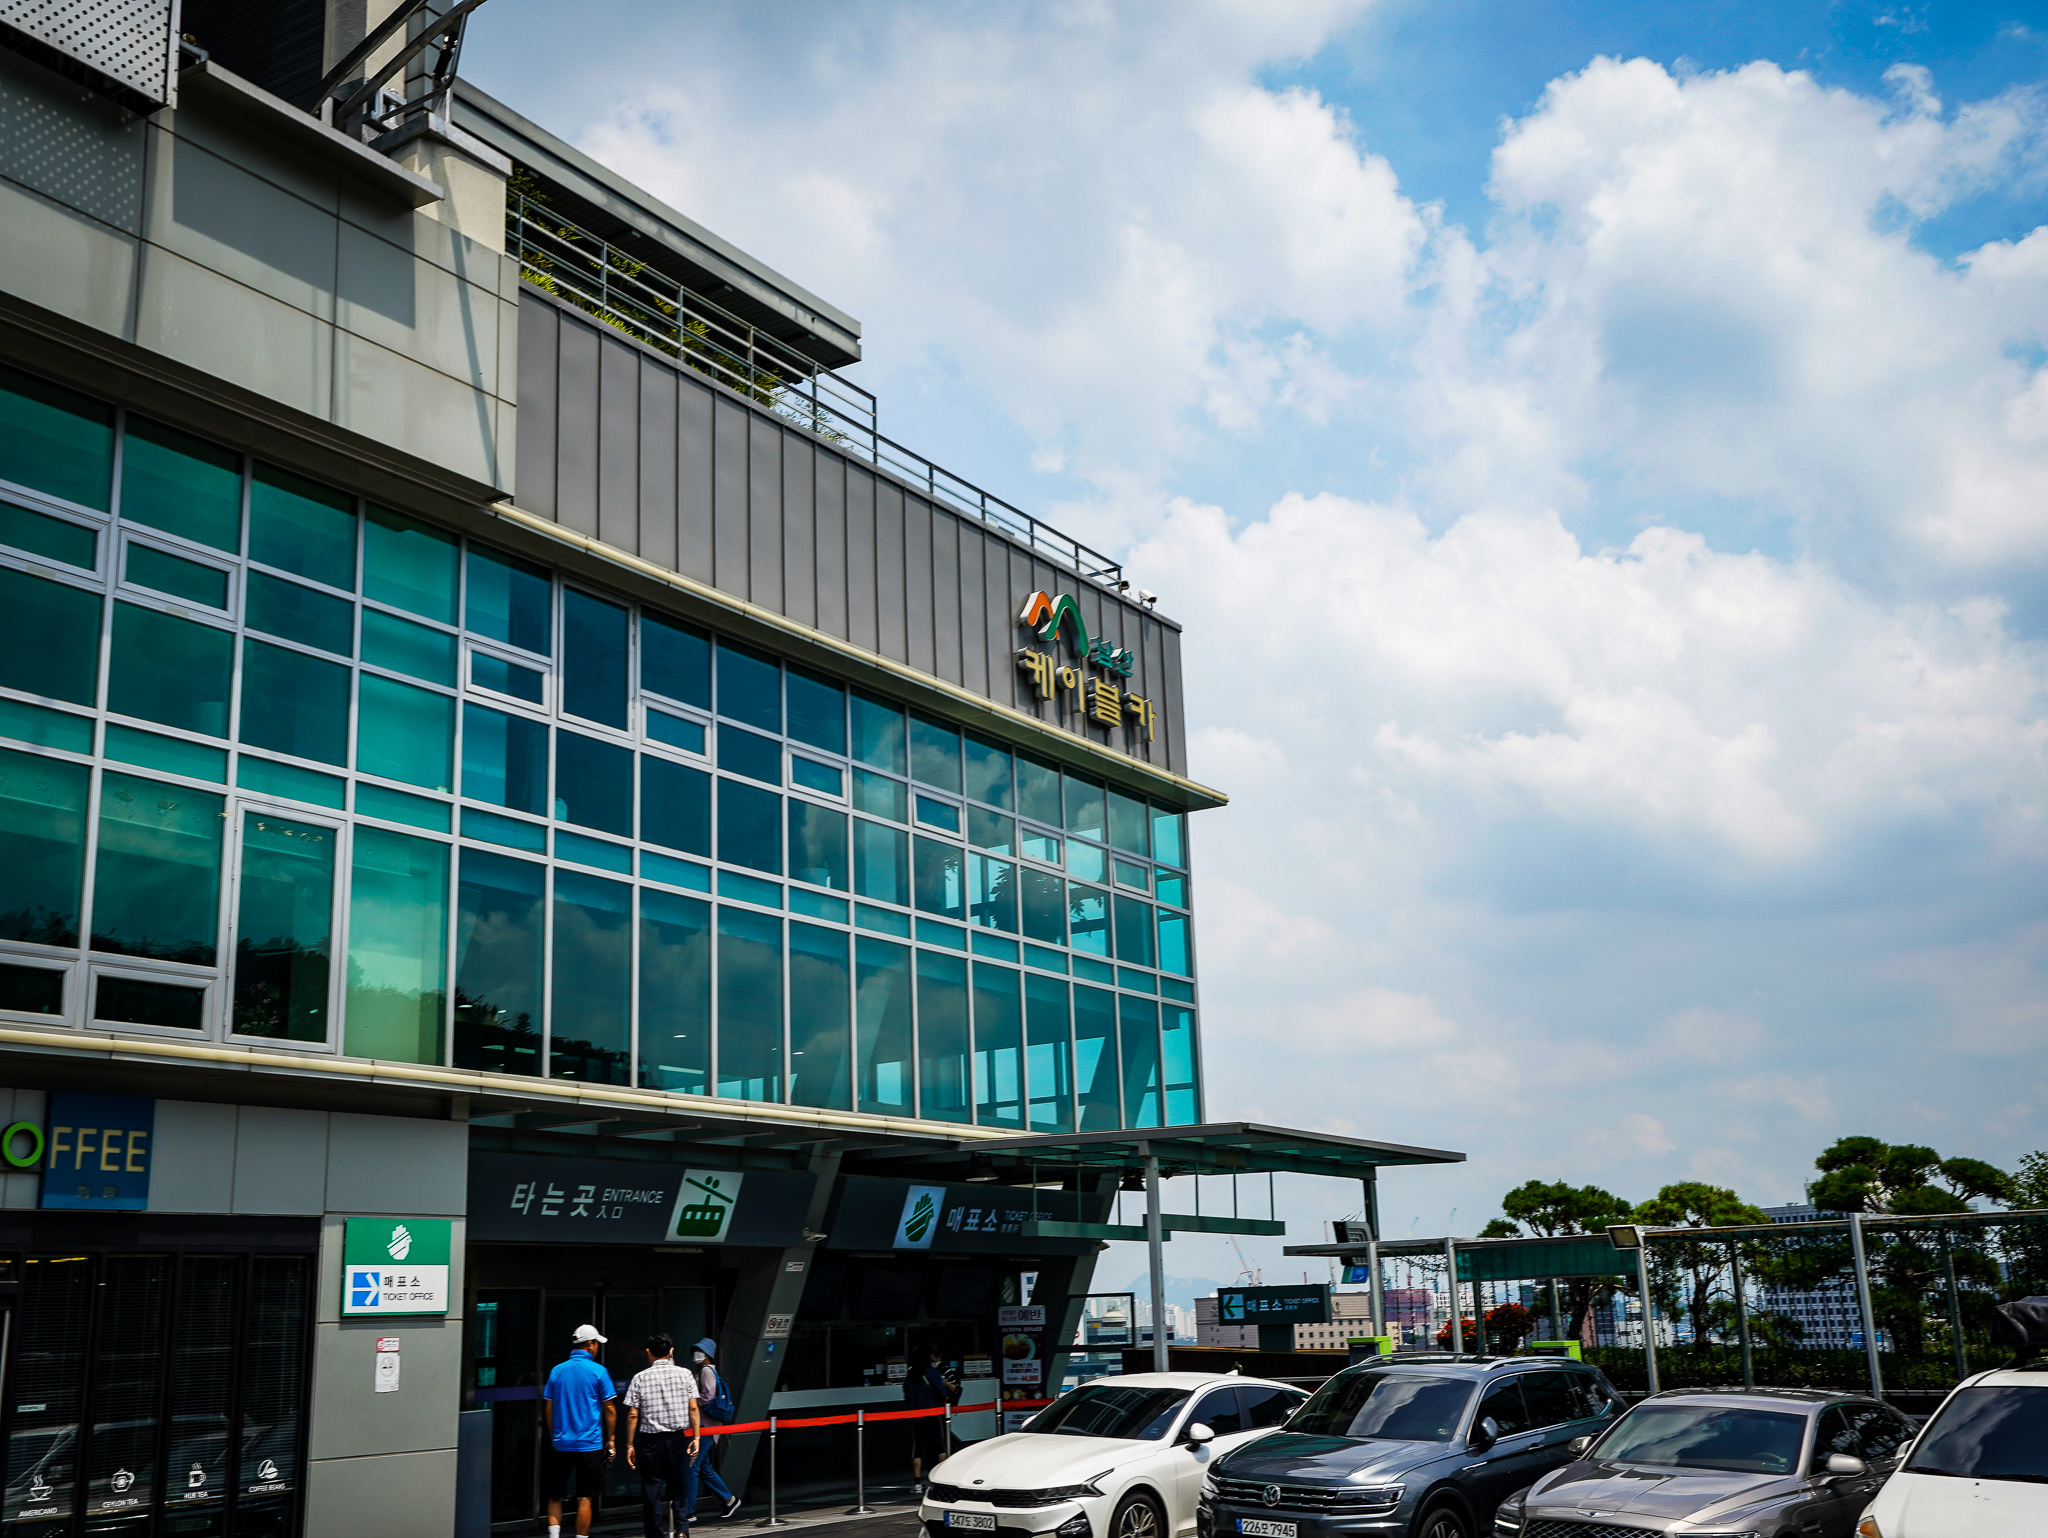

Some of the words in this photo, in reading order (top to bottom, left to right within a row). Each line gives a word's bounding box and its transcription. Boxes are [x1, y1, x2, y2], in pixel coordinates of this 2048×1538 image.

[1015, 647, 1157, 742] 케이블카
[602, 1188, 664, 1204] ENTRANCE
[946, 1206, 998, 1232] 매표소
[383, 1275, 421, 1288] 매표소
[383, 1292, 408, 1301] TICKET
[409, 1292, 434, 1301] OFFICE
[1246, 1299, 1283, 1313] 매표소
[248, 1485, 268, 1493] COFFEE
[18, 1507, 58, 1517] AMERICANO
